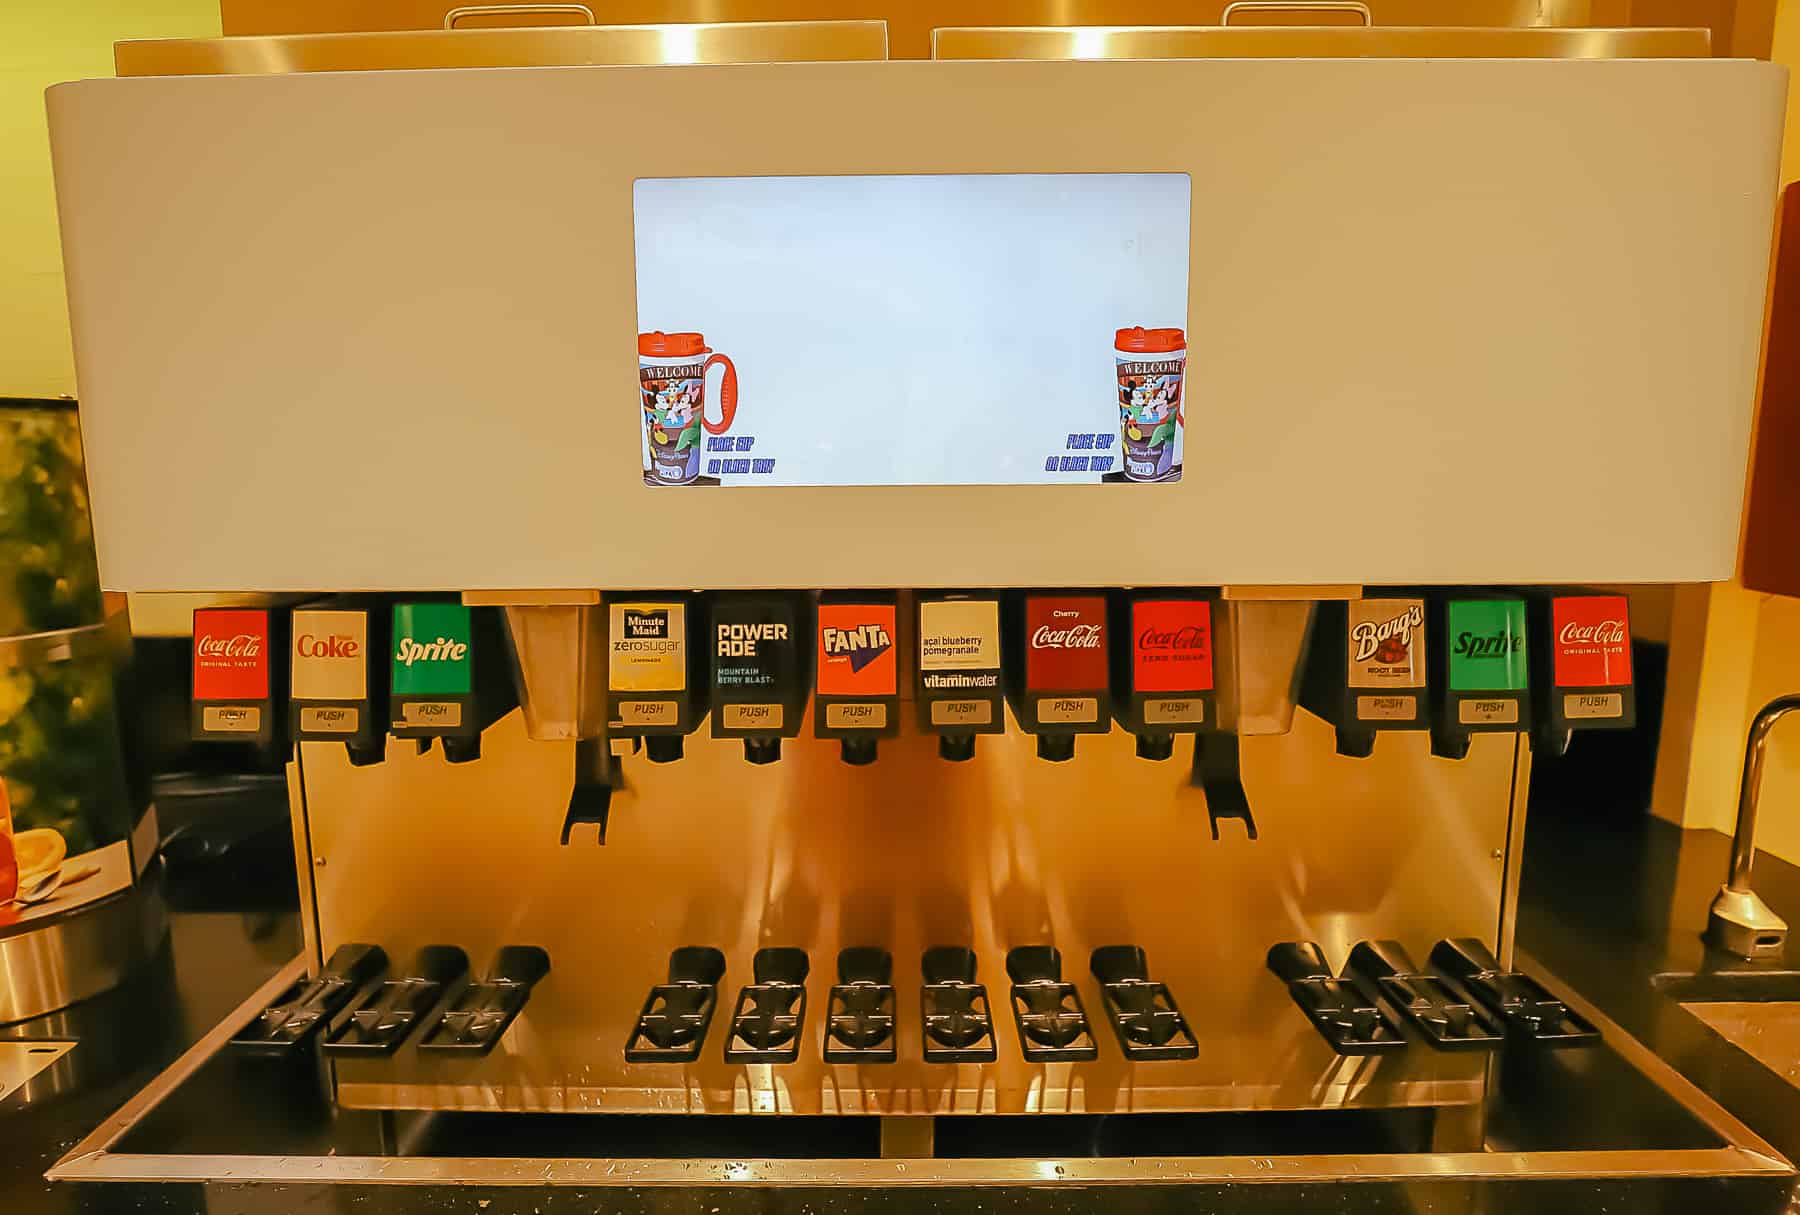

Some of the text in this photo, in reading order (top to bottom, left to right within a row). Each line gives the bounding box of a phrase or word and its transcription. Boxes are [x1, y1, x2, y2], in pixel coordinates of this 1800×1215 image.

[646, 365, 703, 379] WELCOME
[1067, 434, 1115, 449] PLACE CUP
[1053, 610, 1080, 618] Cherry
[628, 616, 665, 627] Minute
[632, 626, 660, 636] Maid
[718, 624, 788, 640] POWER
[1351, 605, 1424, 662] Barq's
[297, 634, 360, 658] Coke
[942, 636, 982, 646] blueberry
[1454, 630, 1522, 659] Sprite
[396, 637, 467, 667] Sprite
[718, 640, 756, 656] ADE
[923, 646, 980, 656] pomegranate
[1564, 648, 1600, 656] ORIGINAL
[718, 667, 759, 675] MOUNTAIN
[718, 676, 742, 684] BERRY
[924, 674, 998, 688] vitaminwater
[1053, 701, 1084, 712] PUSH
[1475, 702, 1505, 712] PUSH
[1579, 697, 1609, 707] PUSH
[418, 705, 447, 715] PUSH
[634, 704, 665, 714] PUSH
[739, 707, 770, 717] PUSH
[842, 707, 873, 717] PUSH
[947, 703, 977, 713] PUSH
[1160, 703, 1189, 713] PUSH
[316, 711, 345, 721] PUSH
